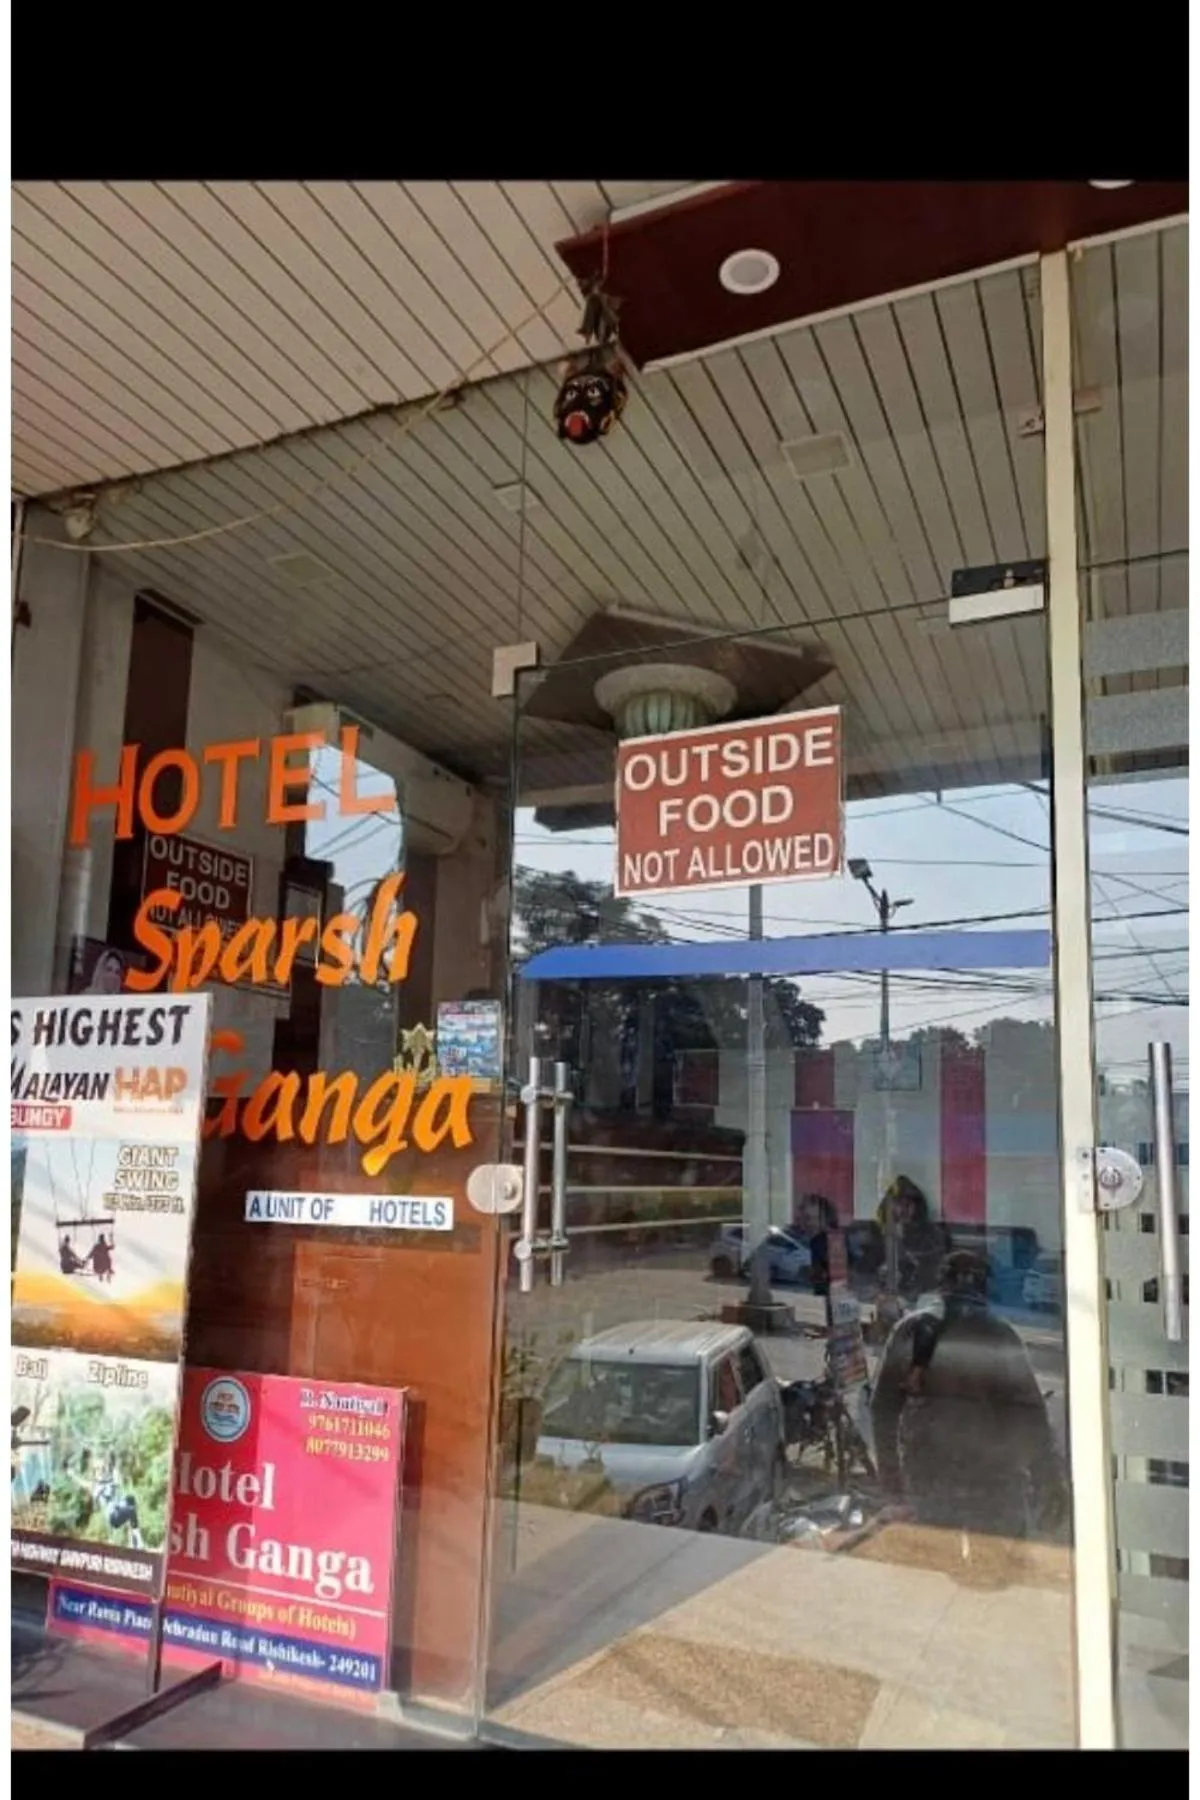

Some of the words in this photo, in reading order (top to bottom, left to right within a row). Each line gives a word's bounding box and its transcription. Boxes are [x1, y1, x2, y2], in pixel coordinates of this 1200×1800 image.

[624, 726, 834, 791] OUTSIDE
[70, 724, 396, 848] HOTEL
[659, 785, 794, 837] FOOD
[150, 835, 248, 887] OUTSIDE
[623, 849, 680, 888] NOT
[687, 832, 834, 880] ALLOWED
[124, 871, 417, 994] Sparsh
[33, 1005, 191, 1047] HIGHEST
[114, 1066, 188, 1101] HAP
[118, 1145, 178, 1167] GIANT
[115, 1169, 179, 1191] SWING
[250, 1196, 262, 1218] A
[266, 1194, 305, 1219] UNIT
[311, 1198, 335, 1220] OF
[369, 1200, 446, 1226] HOTELS
[88, 1361, 149, 1388] Zipline
[227, 1522, 374, 1601] Ganga
[277, 1605, 297, 1625] of
